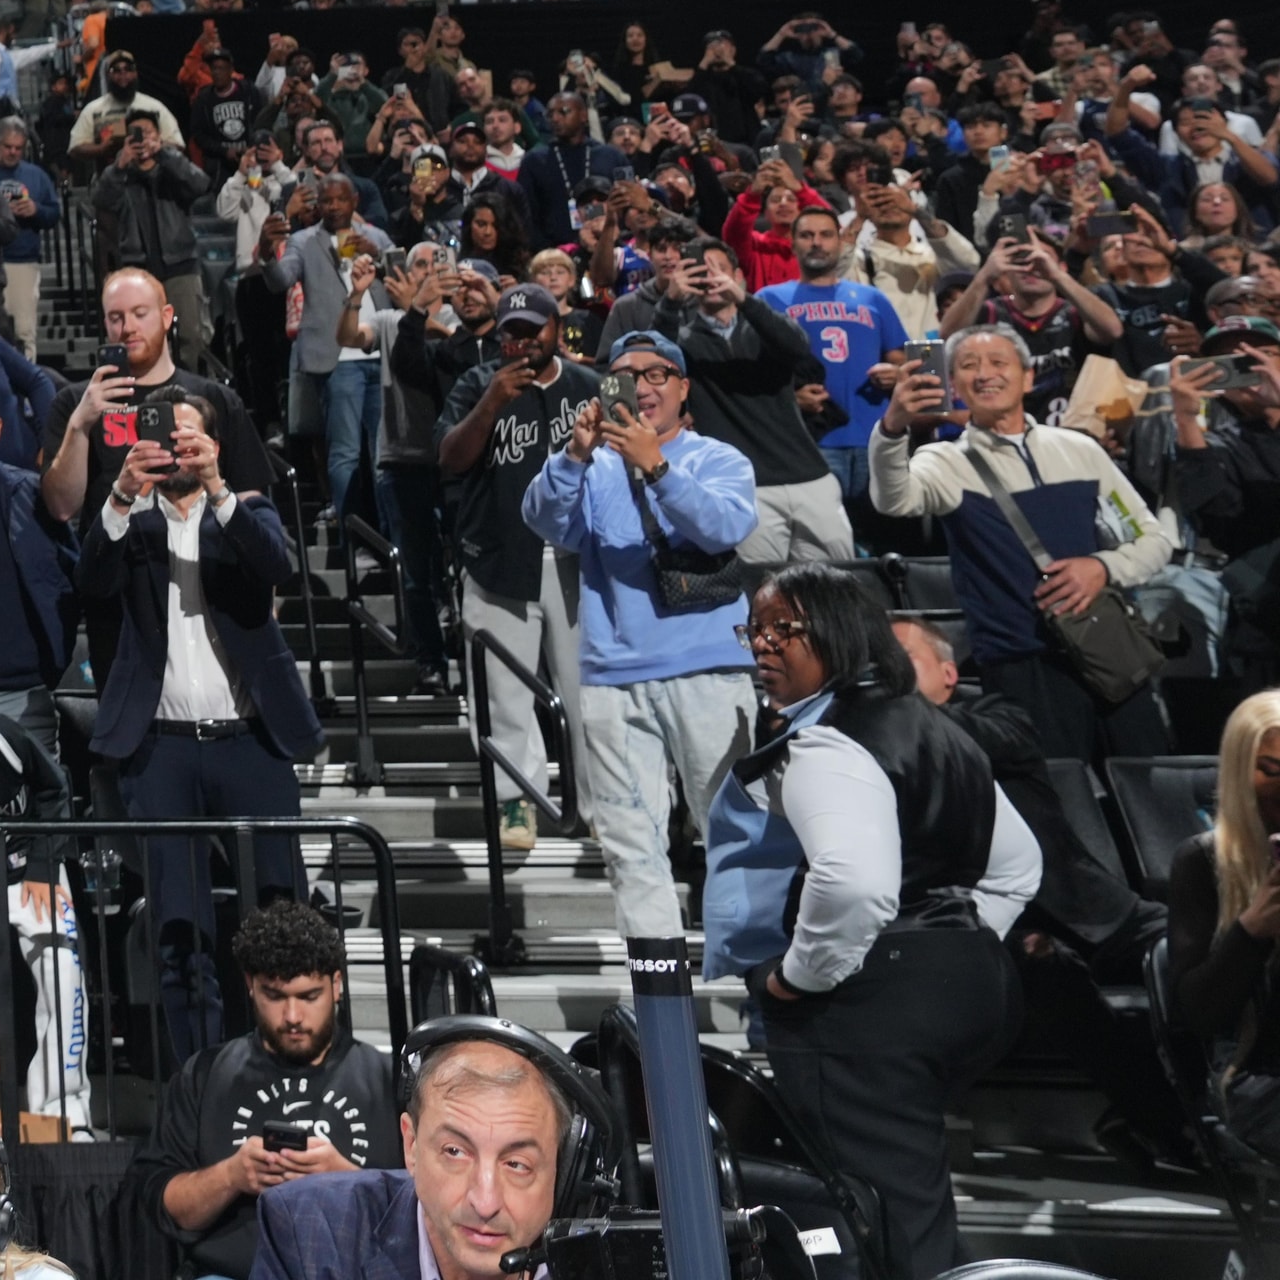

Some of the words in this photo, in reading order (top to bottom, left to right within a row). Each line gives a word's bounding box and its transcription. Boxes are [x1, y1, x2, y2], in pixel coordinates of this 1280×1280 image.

[784, 301, 876, 329] PHILA
[818, 327, 850, 363] 3
[628, 959, 676, 972] TISSOT
[323, 1090, 369, 1168] BASKET
